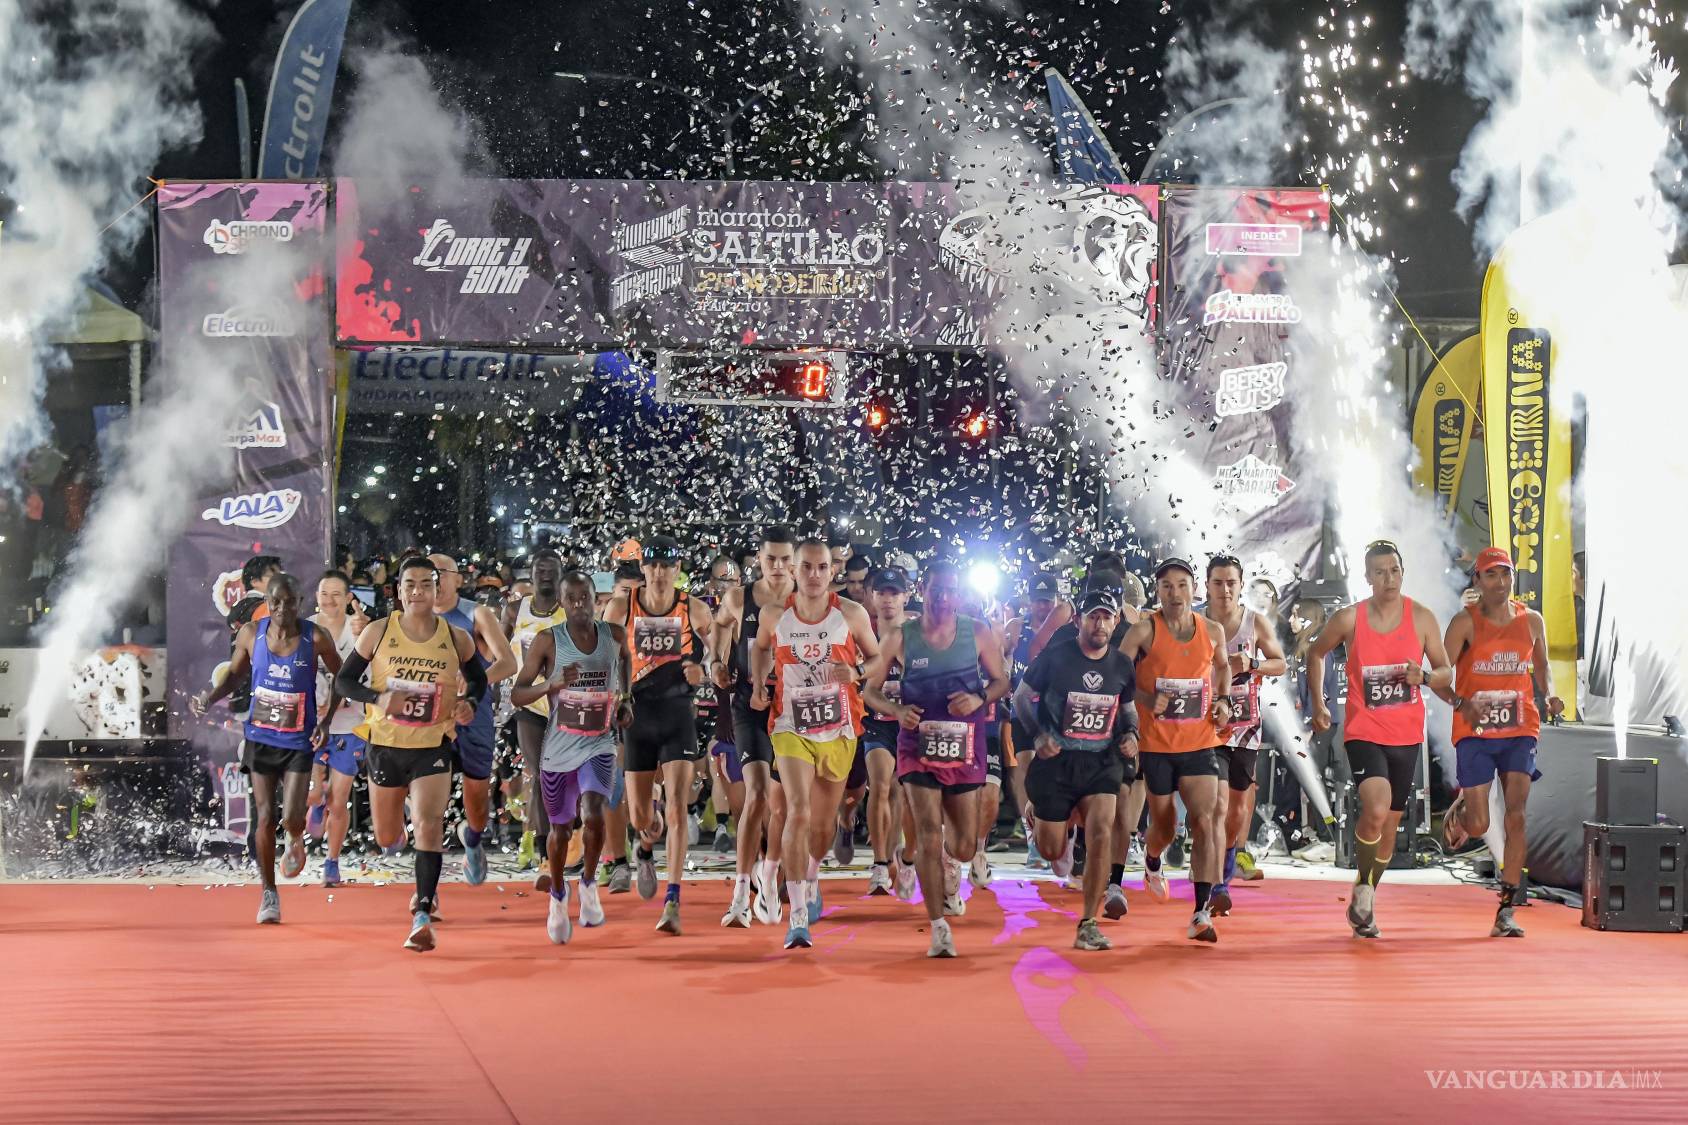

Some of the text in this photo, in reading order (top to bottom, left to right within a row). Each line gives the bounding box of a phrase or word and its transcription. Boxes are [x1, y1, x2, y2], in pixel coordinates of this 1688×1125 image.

[697, 207, 806, 227] maratón
[231, 224, 289, 238] CHRONO
[507, 237, 532, 266] Y
[695, 230, 884, 266] SALTILLO
[460, 265, 530, 294] SUMA
[355, 350, 545, 381] Electrolit
[1226, 367, 1283, 392] BERRY
[1221, 388, 1272, 411] NUTS
[227, 434, 281, 444] arpaMax
[1510, 338, 1544, 574] MODERNA
[223, 495, 284, 520] LALA
[640, 636, 674, 651] 489
[803, 643, 821, 658] 25
[389, 655, 447, 670] PANTERAS
[1493, 652, 1519, 662] CLUB
[394, 668, 440, 683] SNTE
[1371, 682, 1404, 701] 594
[269, 708, 280, 722] 5
[801, 704, 834, 723] 415
[1174, 698, 1186, 714] 2
[577, 711, 586, 726] 1
[1071, 712, 1105, 730] 205
[925, 740, 960, 758] 588
